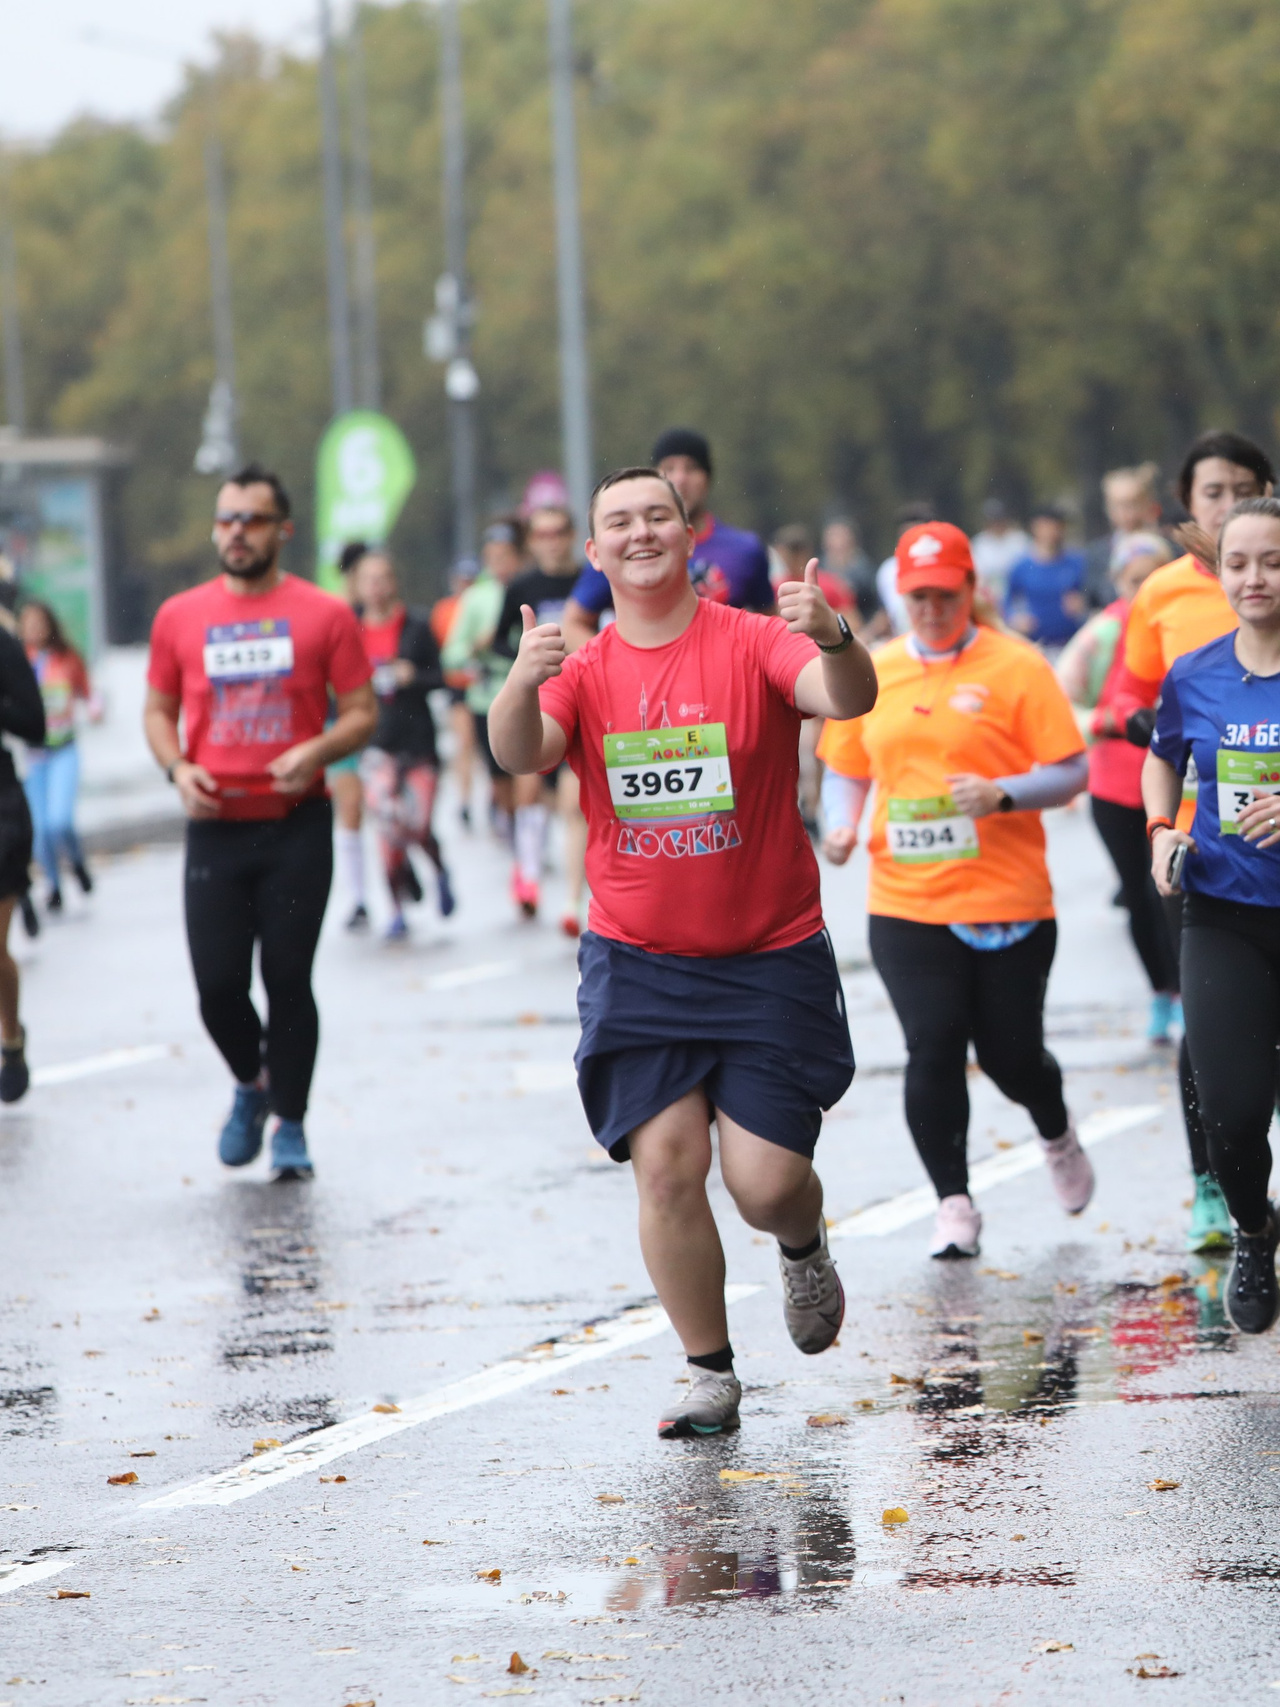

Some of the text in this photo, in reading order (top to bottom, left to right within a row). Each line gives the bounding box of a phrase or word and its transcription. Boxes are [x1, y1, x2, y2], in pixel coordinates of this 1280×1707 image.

[621, 767, 703, 798] 3967
[617, 820, 742, 858] МОСКВА
[894, 825, 954, 848] 3294
